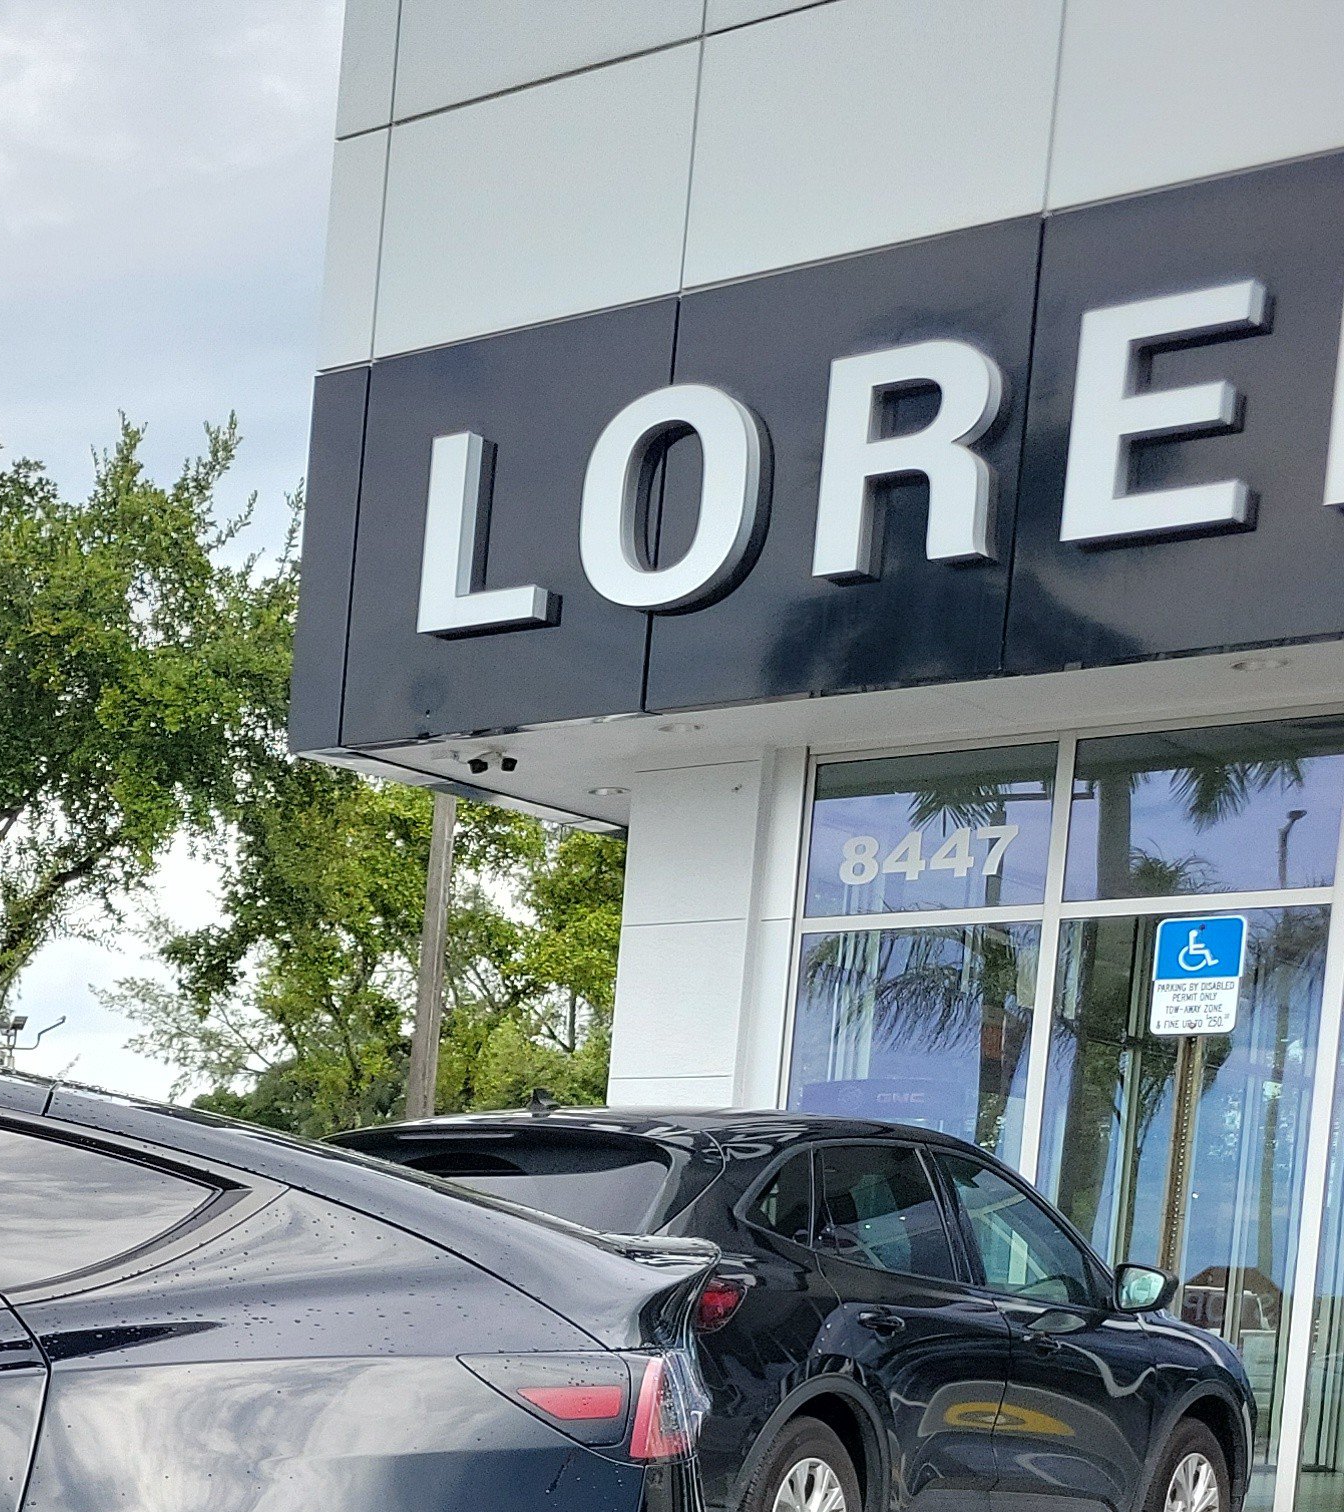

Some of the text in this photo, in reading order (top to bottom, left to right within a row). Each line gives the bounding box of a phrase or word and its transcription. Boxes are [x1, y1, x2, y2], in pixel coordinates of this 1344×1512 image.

[417, 276, 1344, 638] LORE
[839, 826, 1019, 886] 8447
[1157, 981, 1235, 993] PARKING BY DISABLED
[1172, 992, 1218, 1002] PERMIT ONLY
[1165, 1004, 1223, 1014] TOW-AWAY ZONE
[1165, 1020, 1179, 1029] FINE
